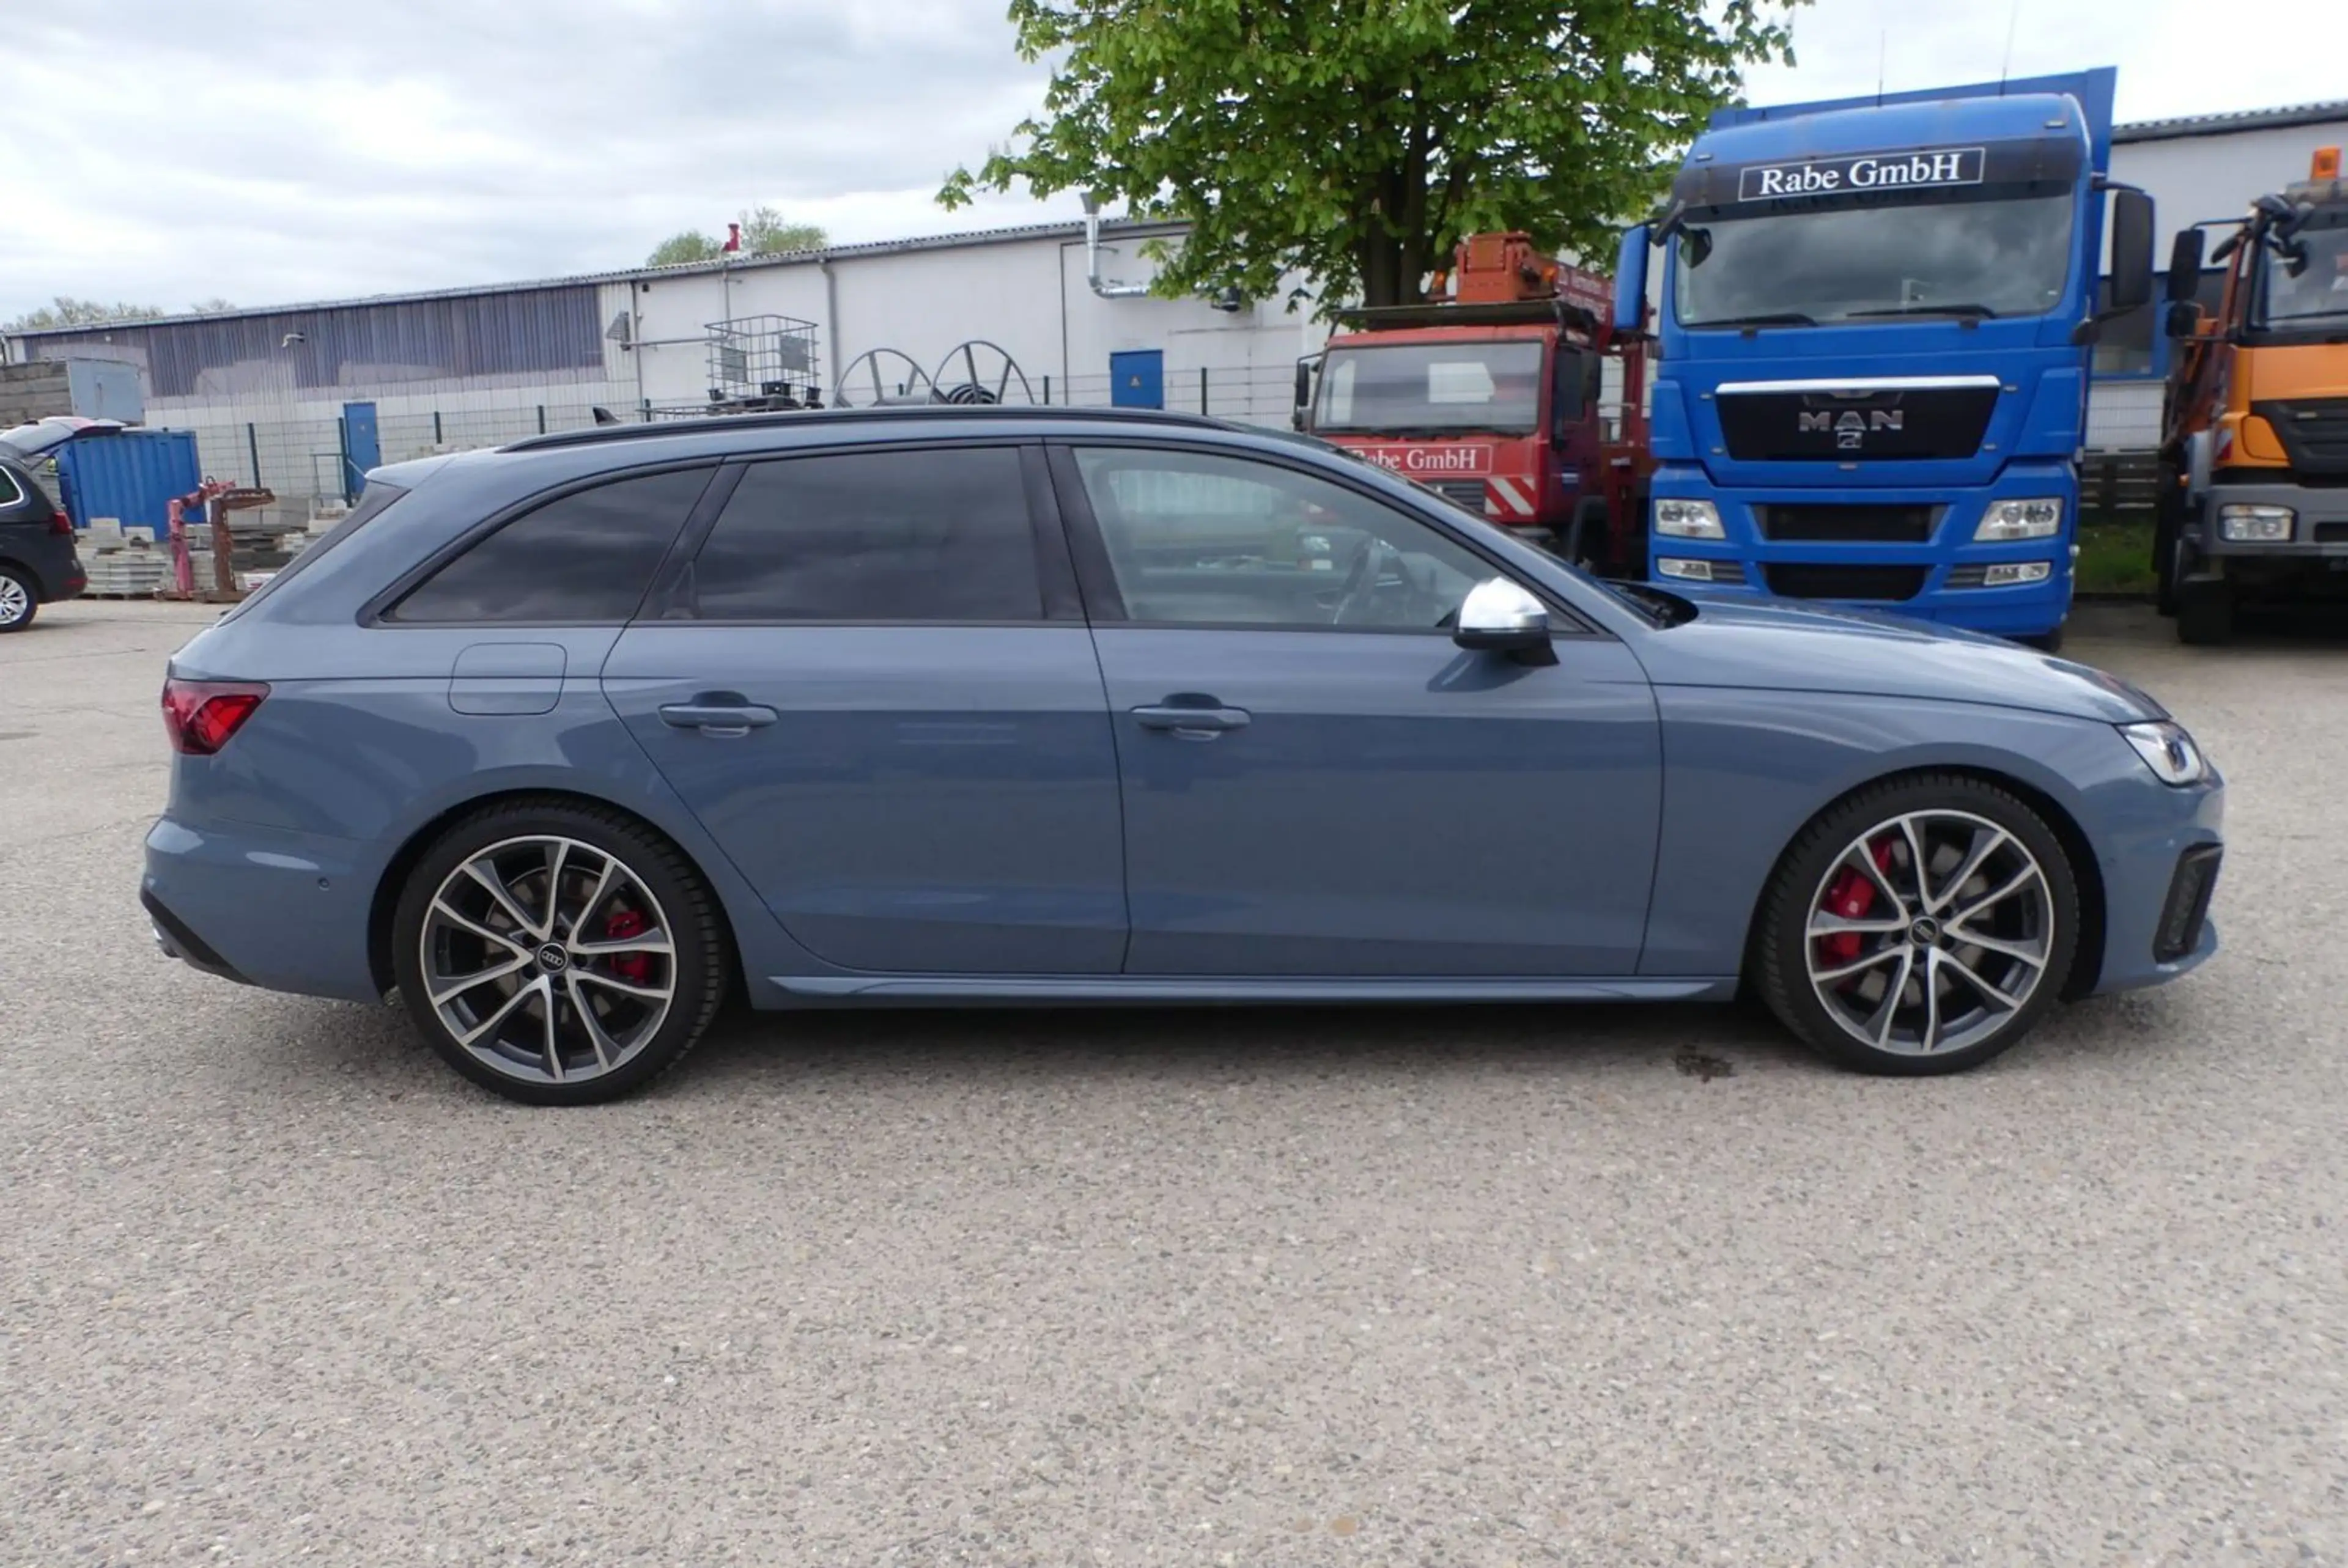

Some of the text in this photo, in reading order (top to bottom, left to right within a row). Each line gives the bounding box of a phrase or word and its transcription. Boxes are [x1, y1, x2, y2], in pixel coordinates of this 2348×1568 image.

[1759, 153, 1962, 195] Rabe GmbH
[1798, 410, 1903, 432] MAN
[1407, 448, 1477, 469] GmbH
